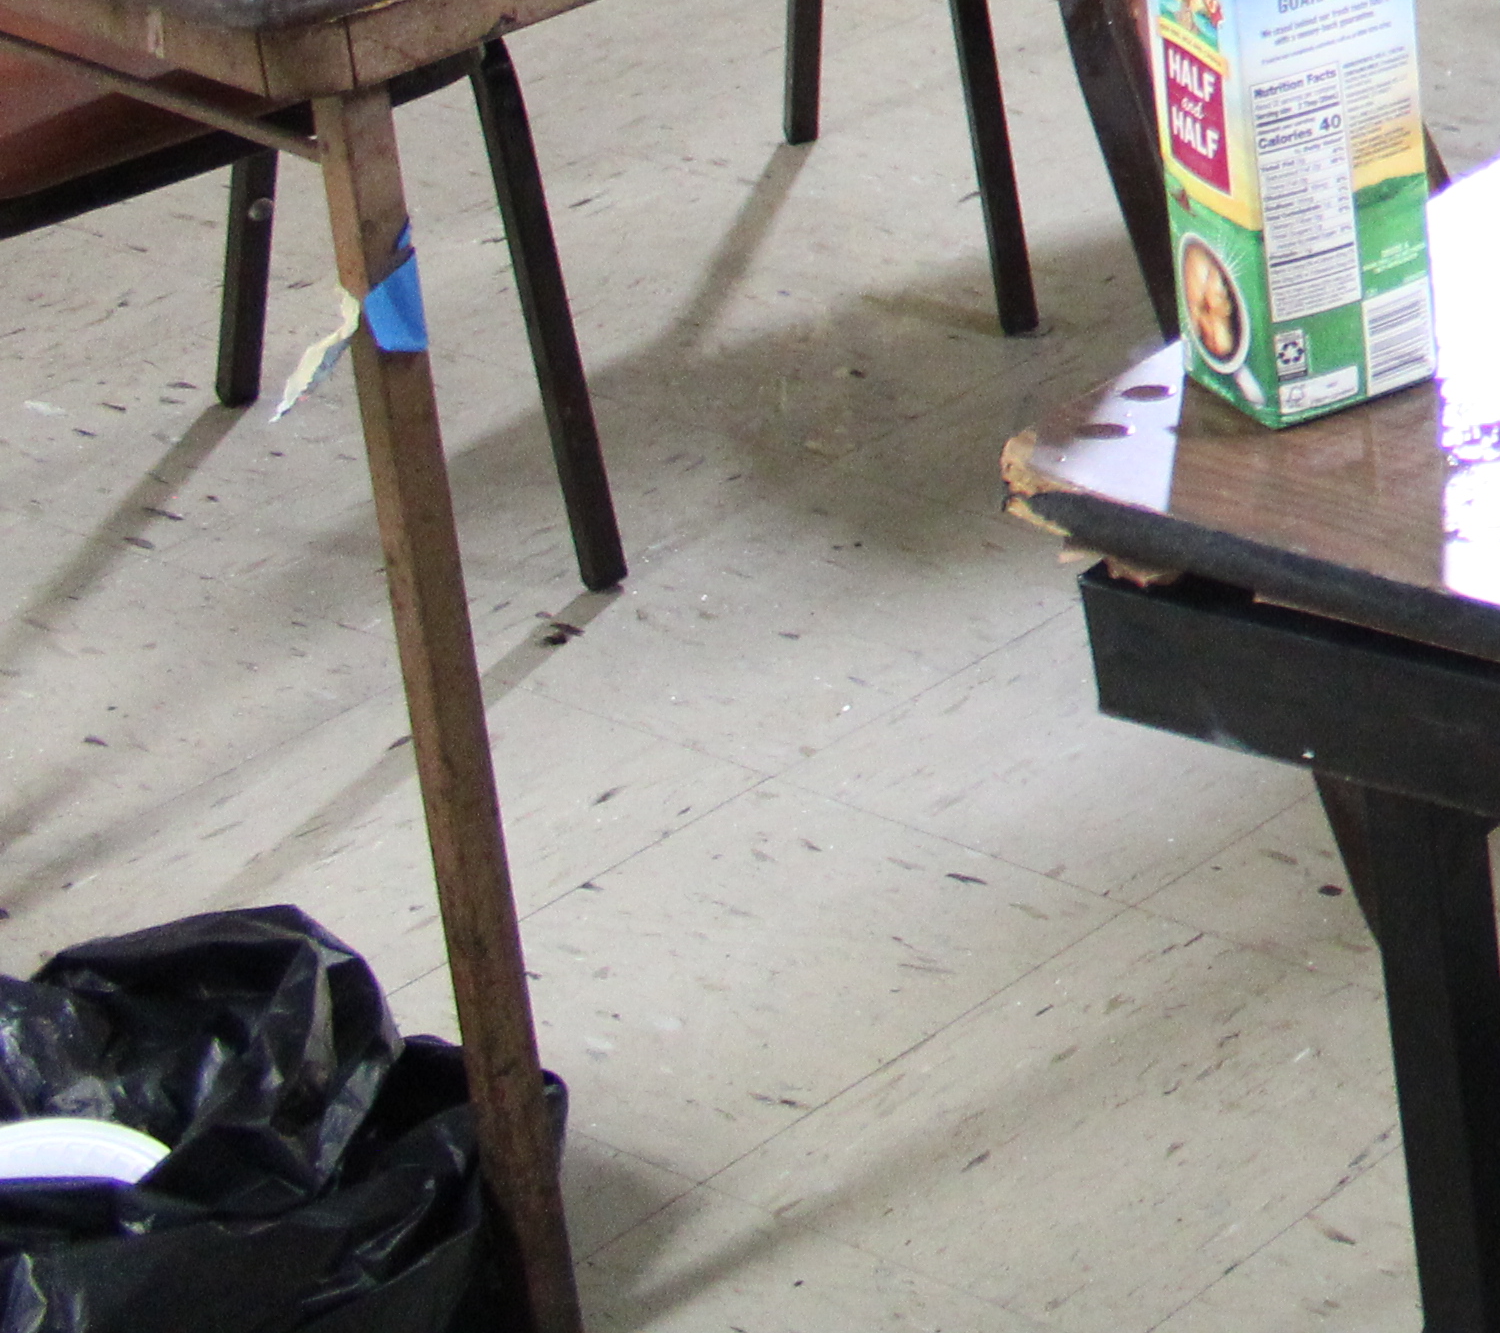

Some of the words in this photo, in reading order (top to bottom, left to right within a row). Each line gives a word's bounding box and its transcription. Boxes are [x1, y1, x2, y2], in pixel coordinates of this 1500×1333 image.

[1168, 43, 1216, 103] HALF
[1254, 79, 1304, 98] Nutrition
[1306, 69, 1337, 84] Facts
[1181, 96, 1206, 120] and
[1171, 106, 1220, 160] HALF
[1258, 127, 1313, 149] Calories
[1318, 114, 1342, 131] 40
